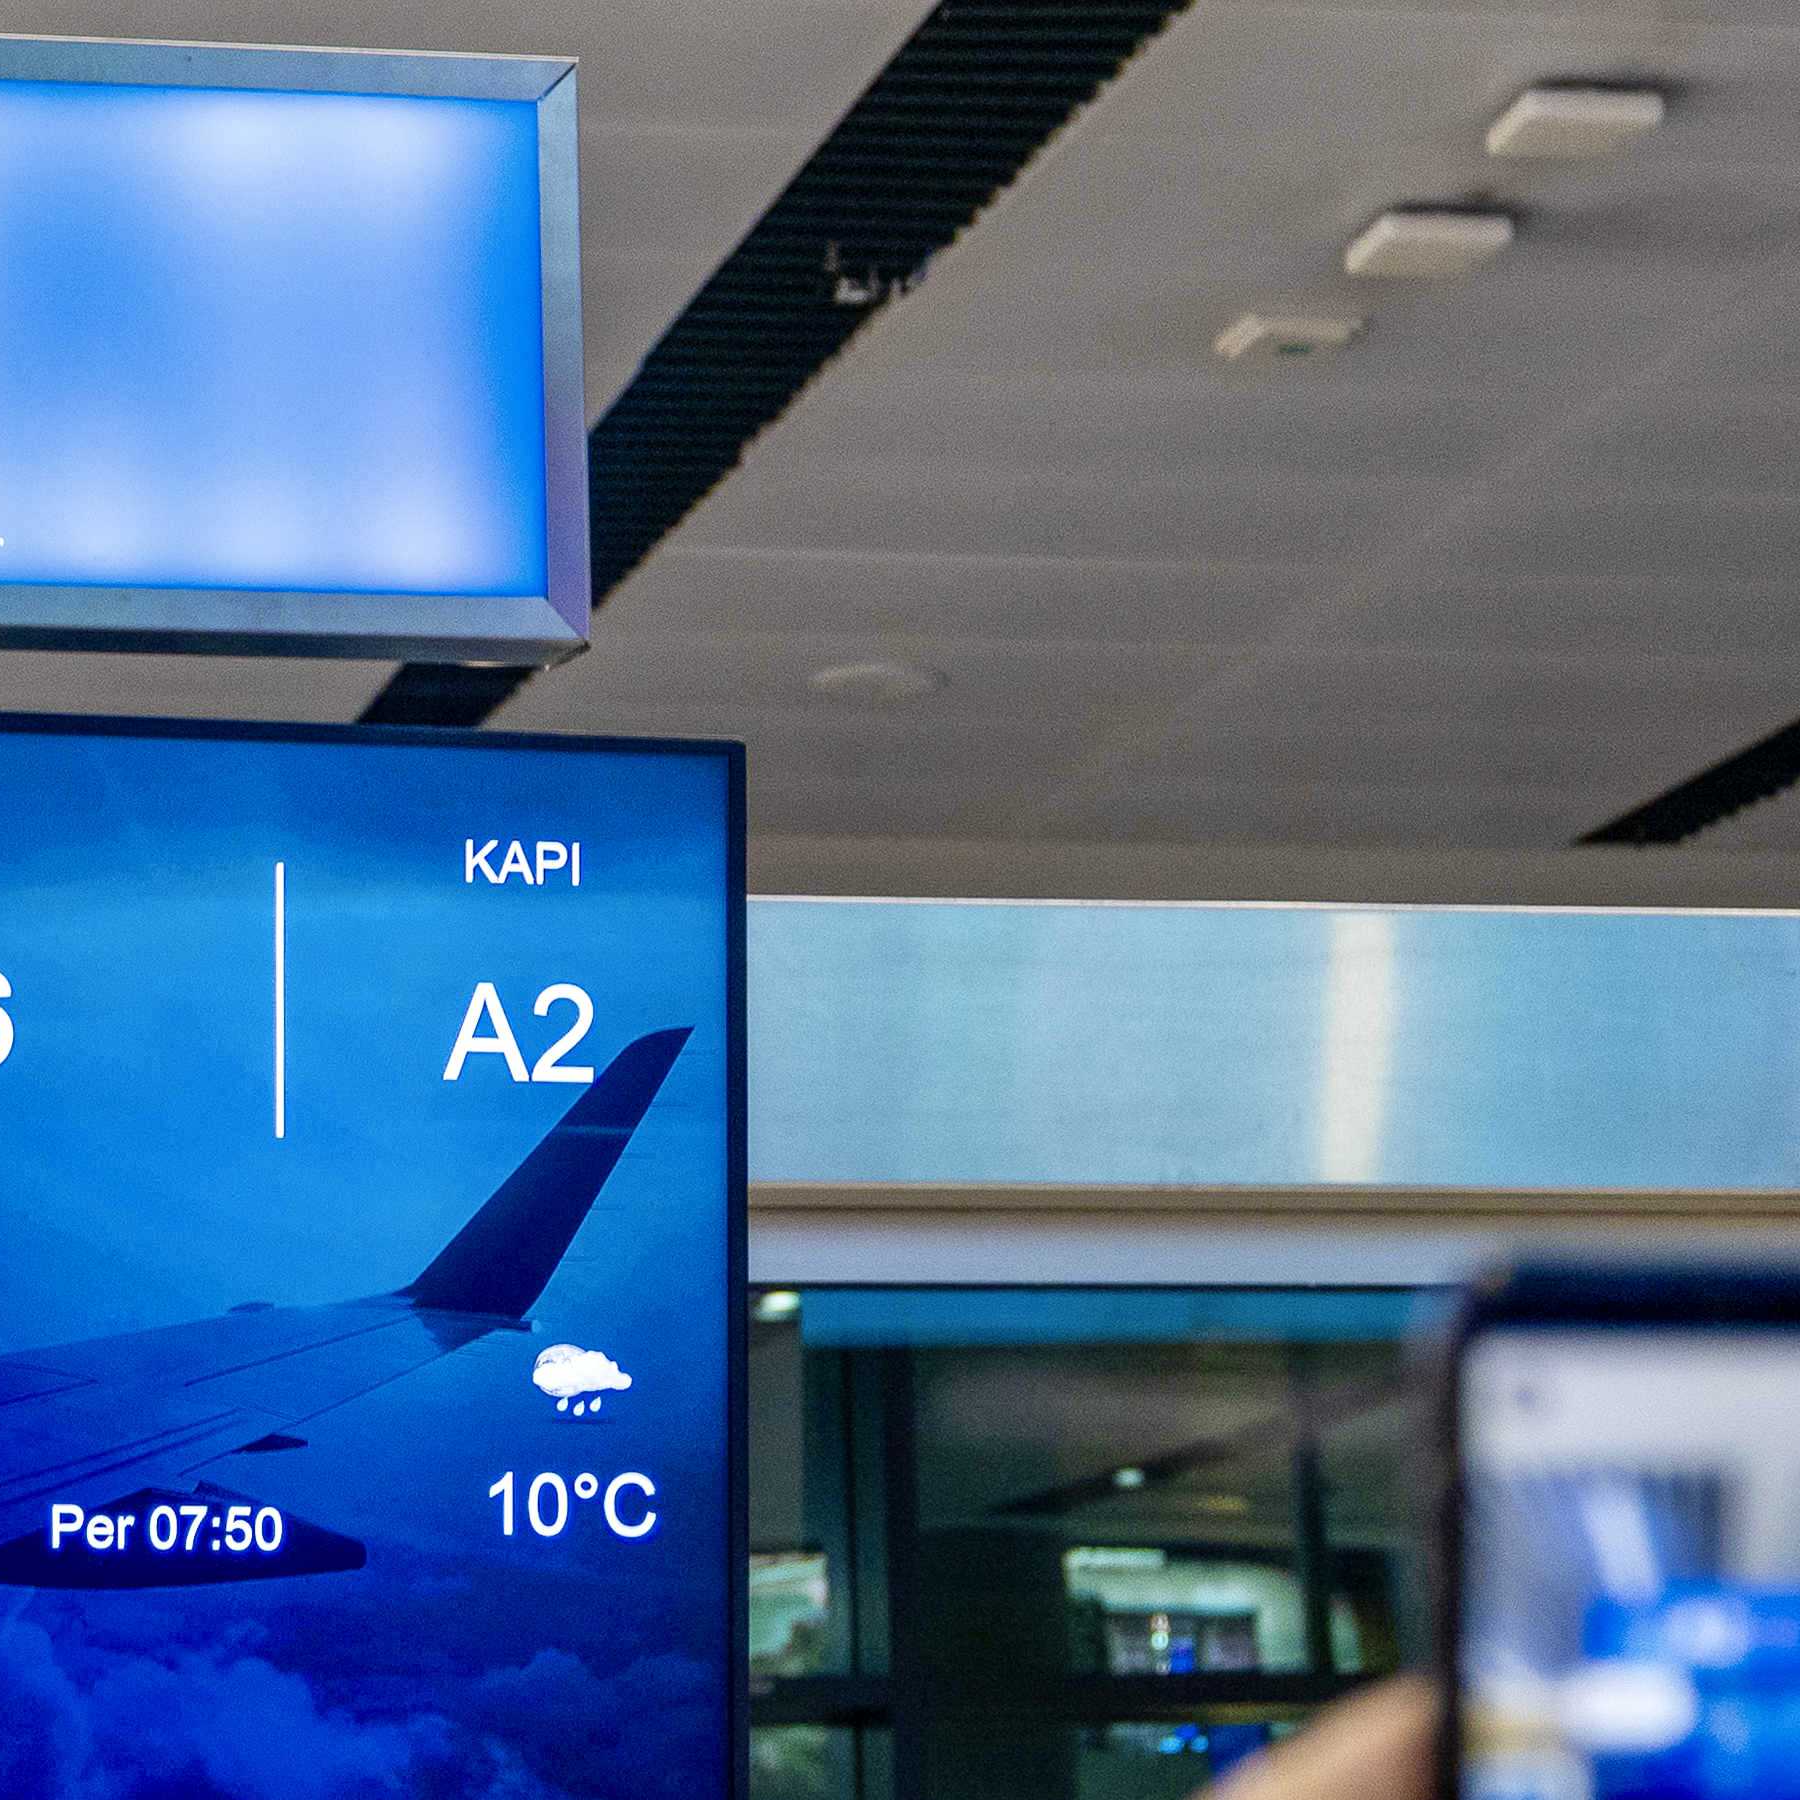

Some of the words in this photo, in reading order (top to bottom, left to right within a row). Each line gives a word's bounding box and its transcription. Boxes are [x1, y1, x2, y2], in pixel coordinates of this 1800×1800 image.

[465, 839, 581, 886] KAPI
[443, 982, 594, 1083] A2
[51, 1503, 136, 1550] Per
[149, 1505, 284, 1552] 07:50
[487, 1471, 658, 1540] 10°C
